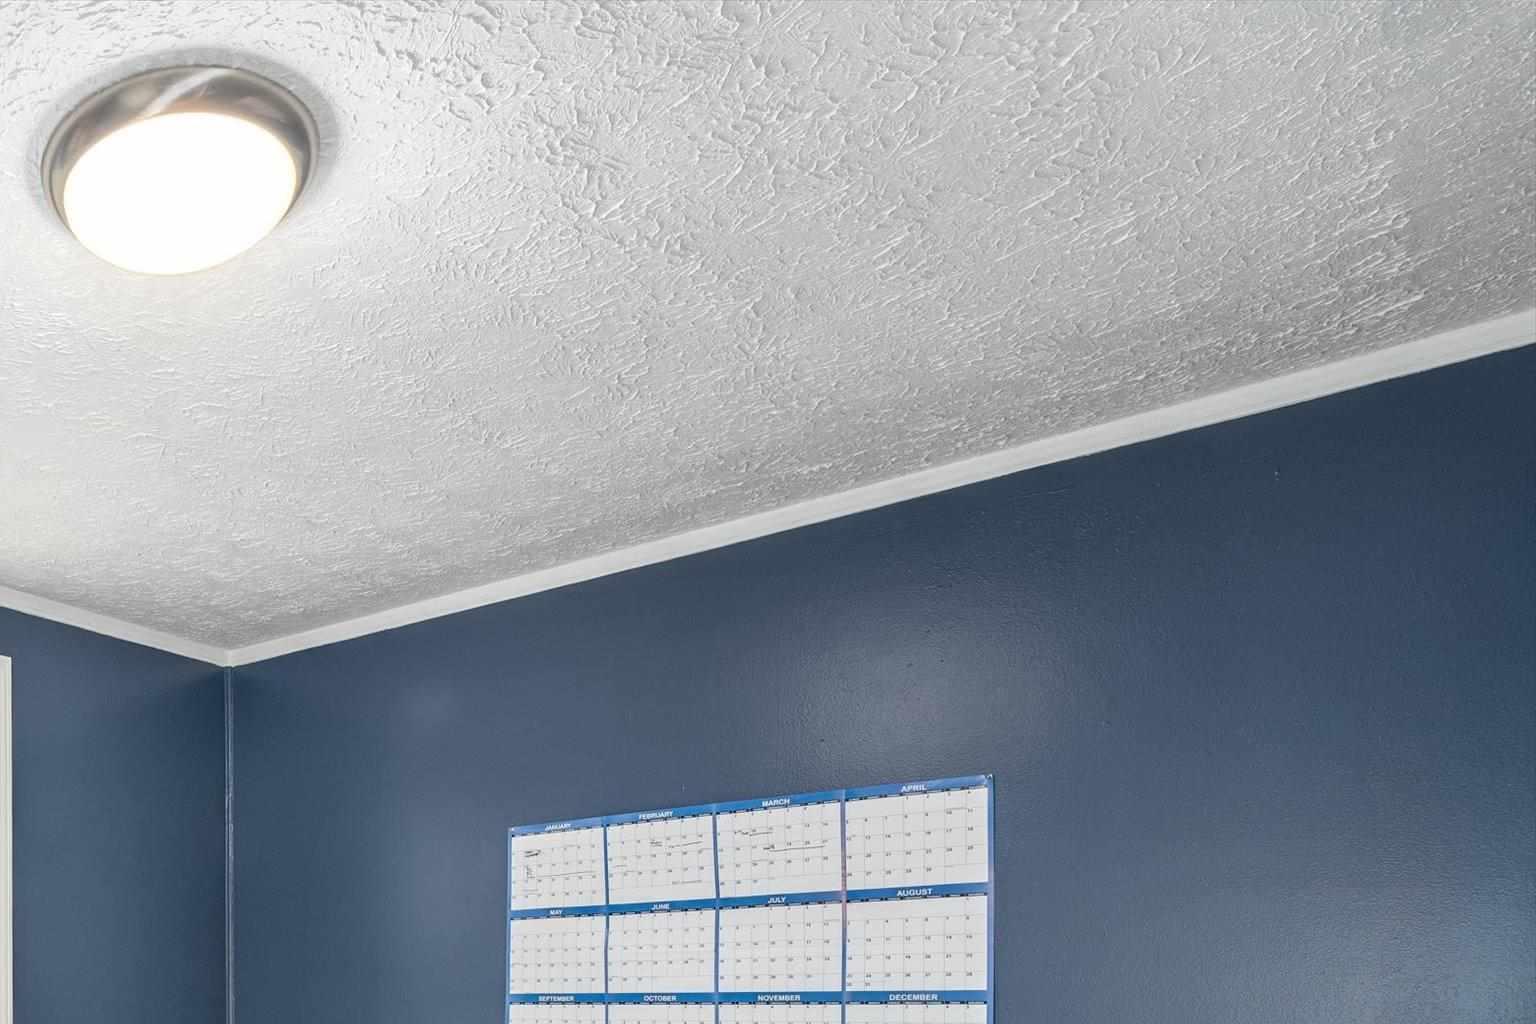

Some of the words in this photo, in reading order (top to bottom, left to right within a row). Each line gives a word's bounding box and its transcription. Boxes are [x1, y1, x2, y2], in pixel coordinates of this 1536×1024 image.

[638, 811, 673, 820] FEBRUARY
[544, 823, 571, 831] JANUARY
[897, 888, 932, 896] AUGUST
[768, 896, 786, 904] JULY
[757, 994, 801, 1002] NOVEMBER
